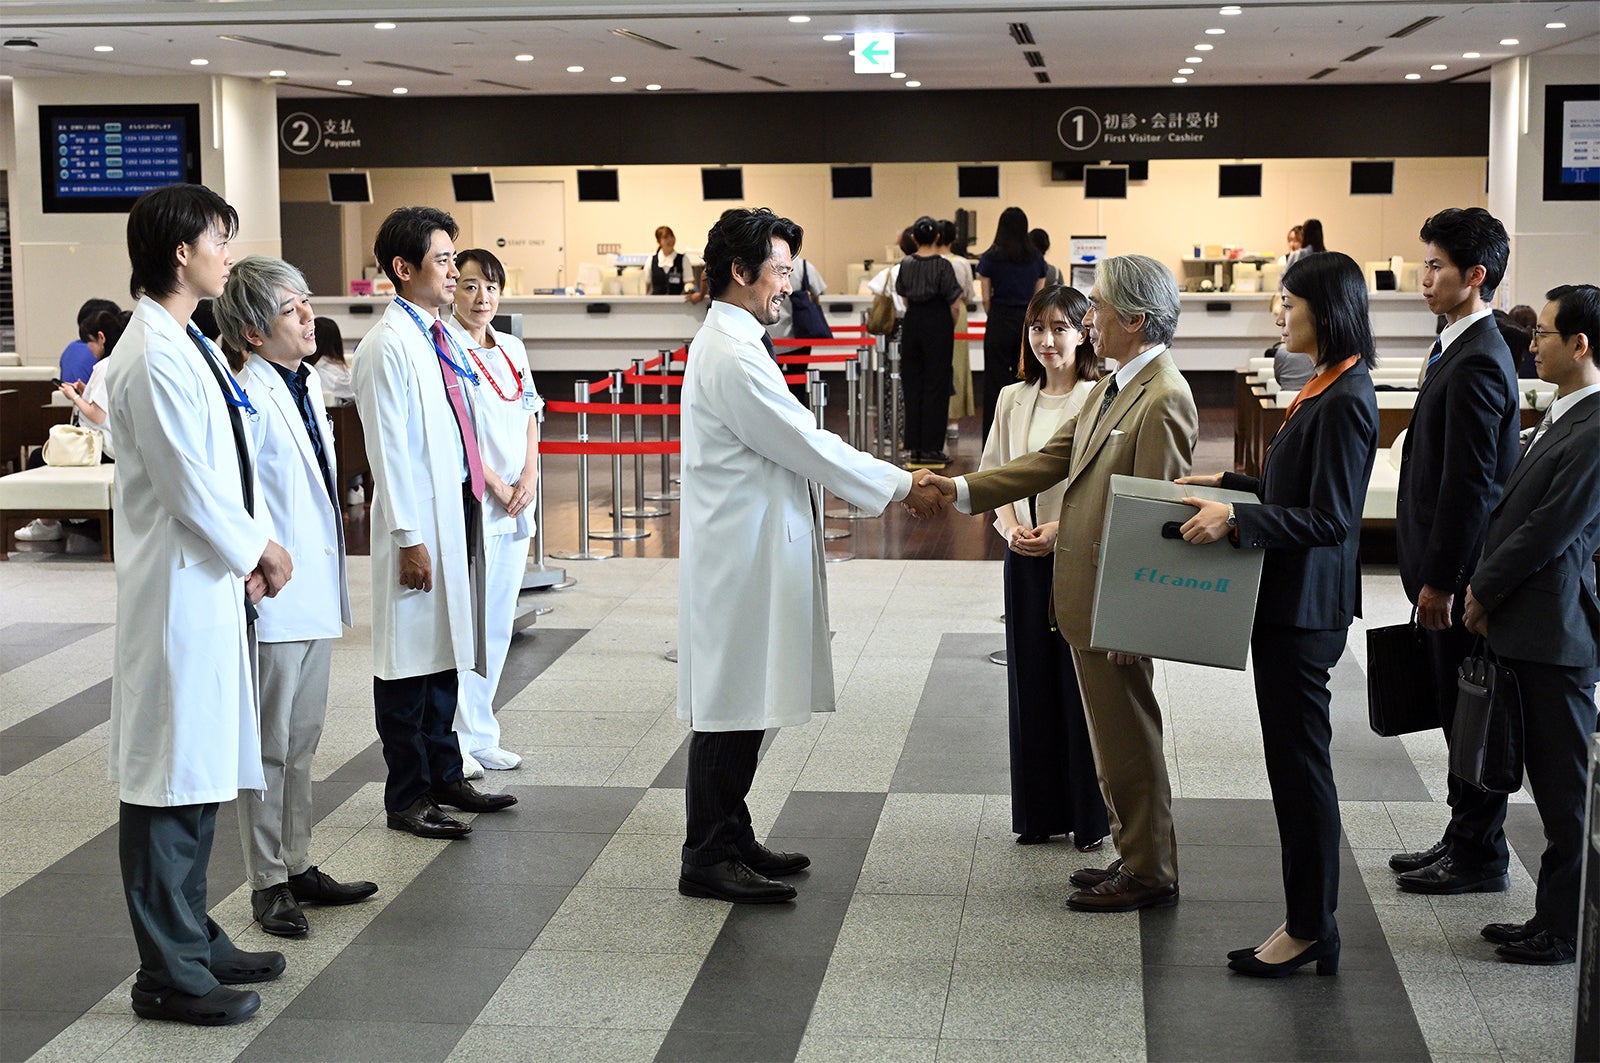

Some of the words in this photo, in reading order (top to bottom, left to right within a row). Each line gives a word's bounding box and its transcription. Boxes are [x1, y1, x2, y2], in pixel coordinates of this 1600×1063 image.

[323, 118, 355, 135] 支払
[1071, 114, 1084, 142] 1
[1104, 111, 1220, 130] 初診・会計受付
[292, 120, 310, 147] 2
[1104, 133, 1126, 143] First
[1128, 133, 1161, 143] Visitor
[1168, 132, 1204, 143] Cashier
[324, 139, 361, 149] Payment
